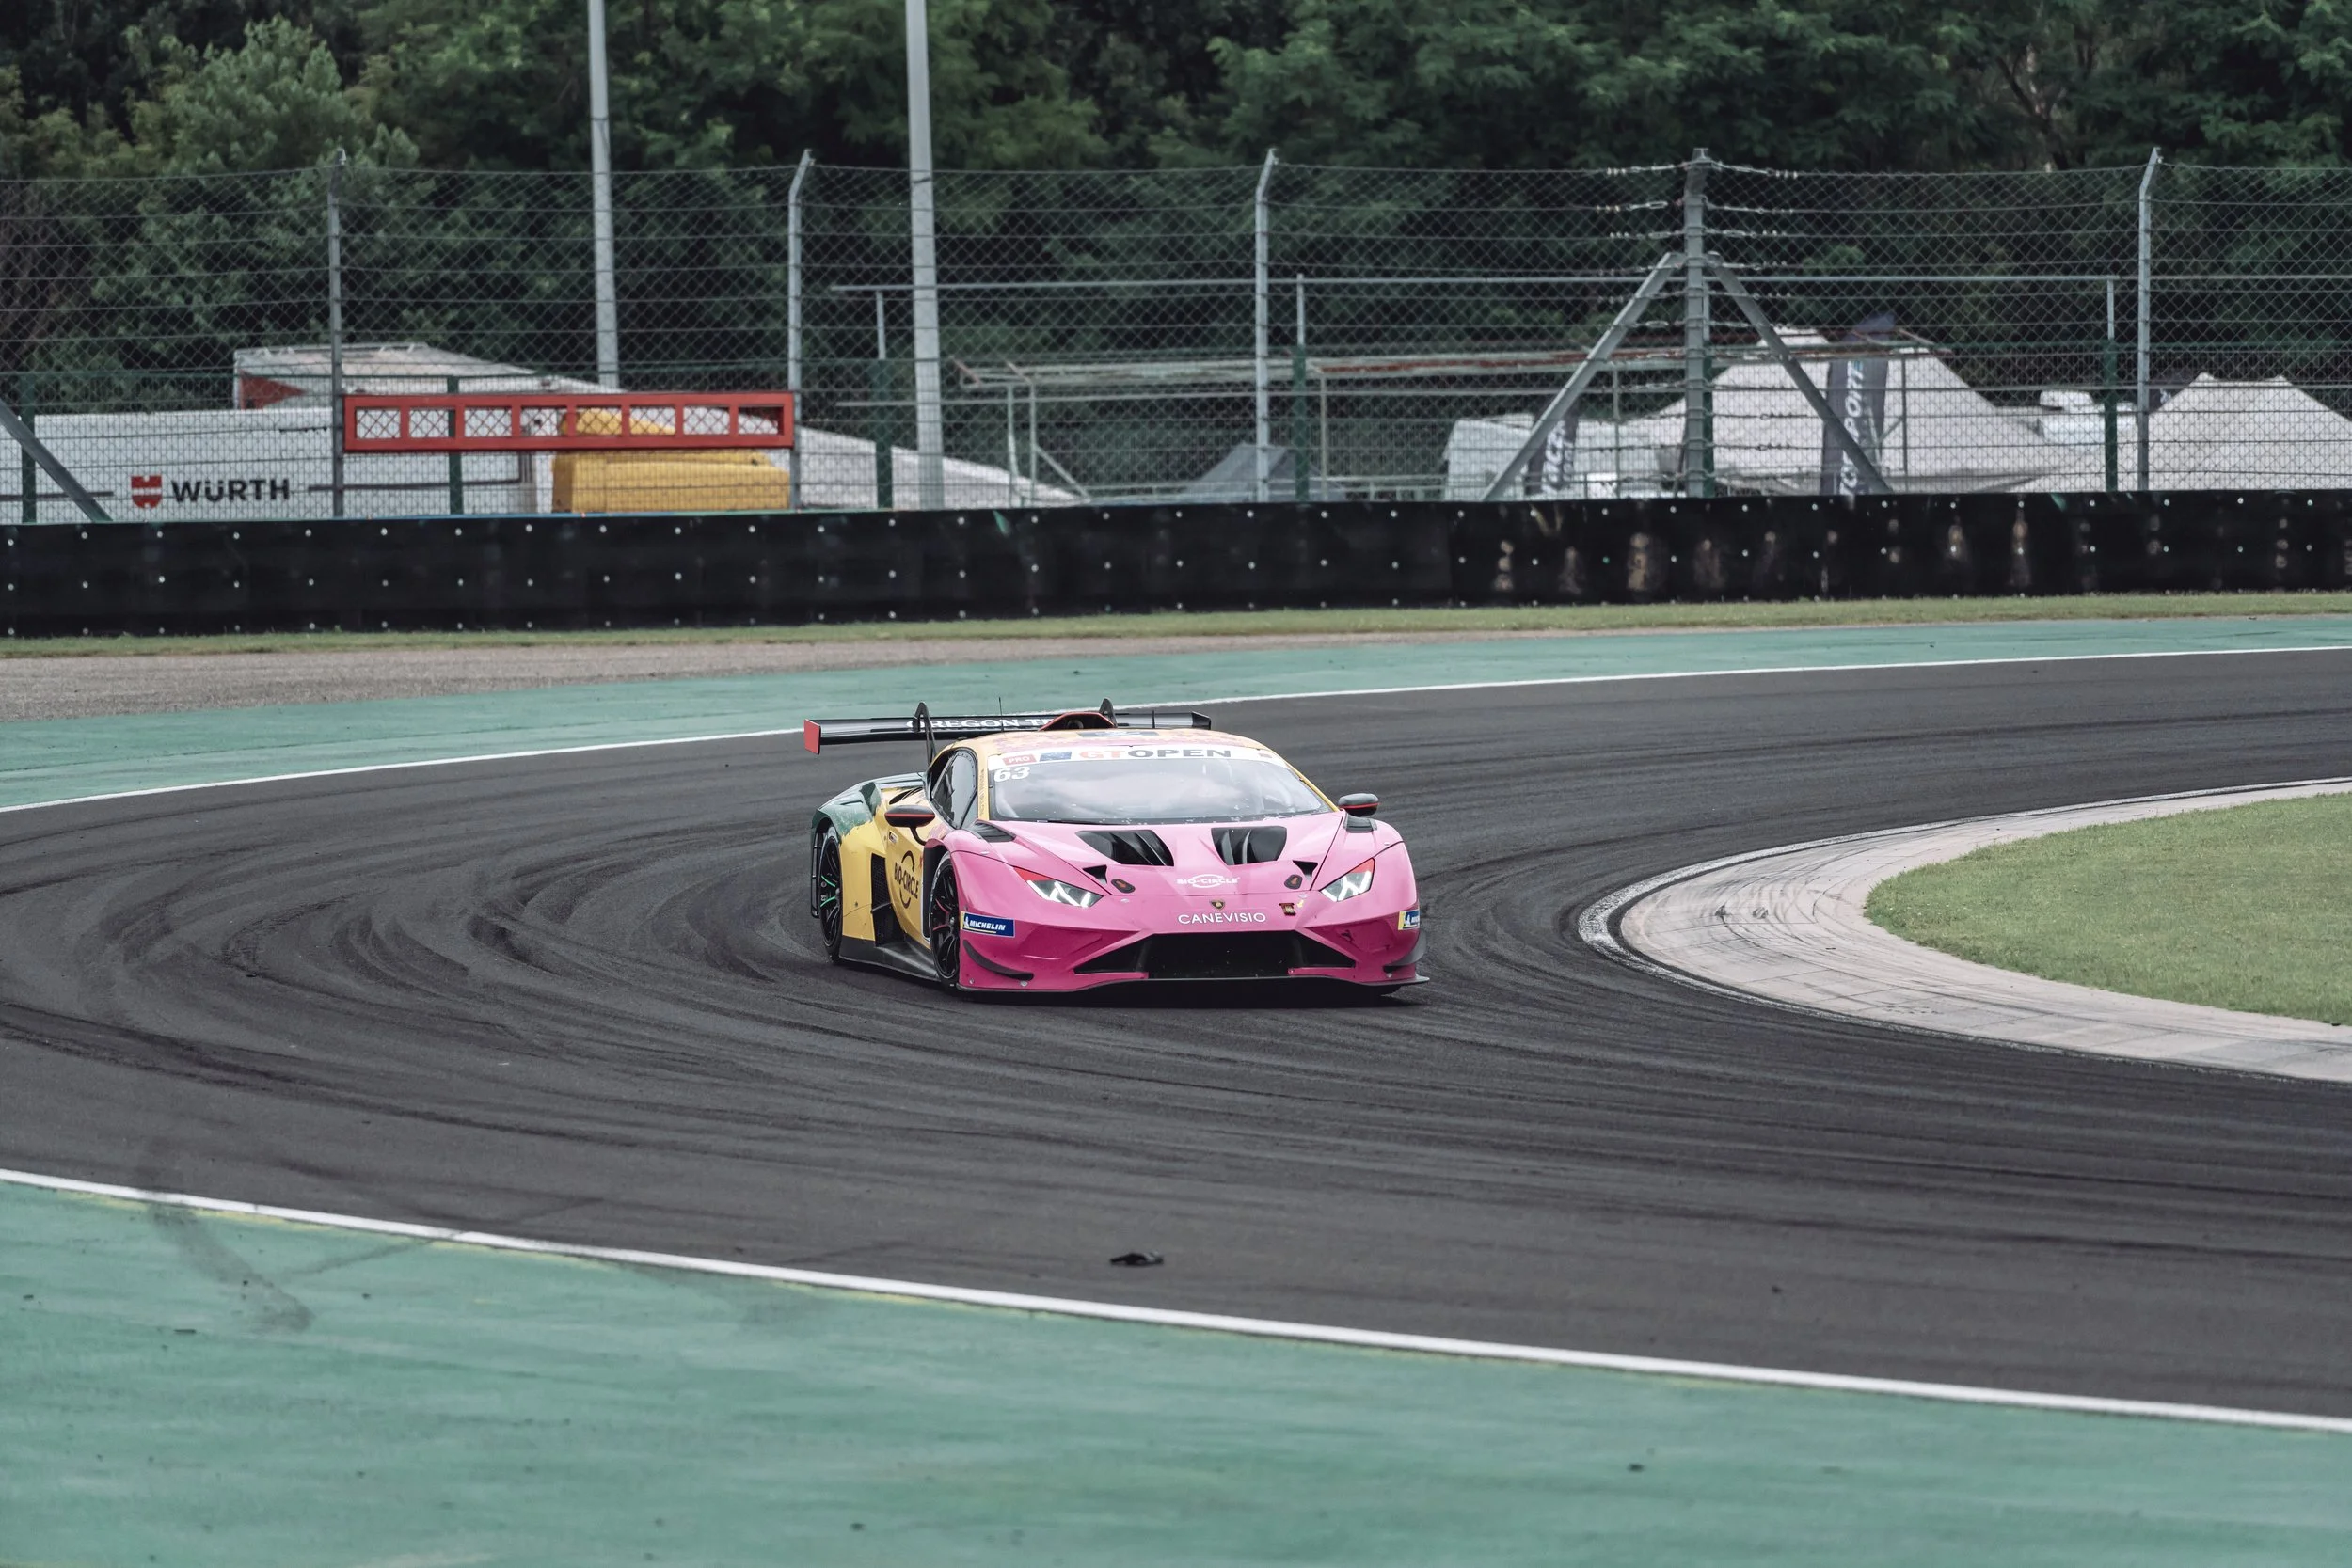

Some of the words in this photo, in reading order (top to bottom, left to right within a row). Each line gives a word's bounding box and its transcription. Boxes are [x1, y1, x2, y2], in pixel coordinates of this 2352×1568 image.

[171, 478, 291, 502] WÜRTH
[1009, 755, 1030, 764] PRO
[993, 766, 1031, 782] 63
[1178, 912, 1266, 924] CANEVISIO
[969, 919, 1007, 931] MICHELIN
